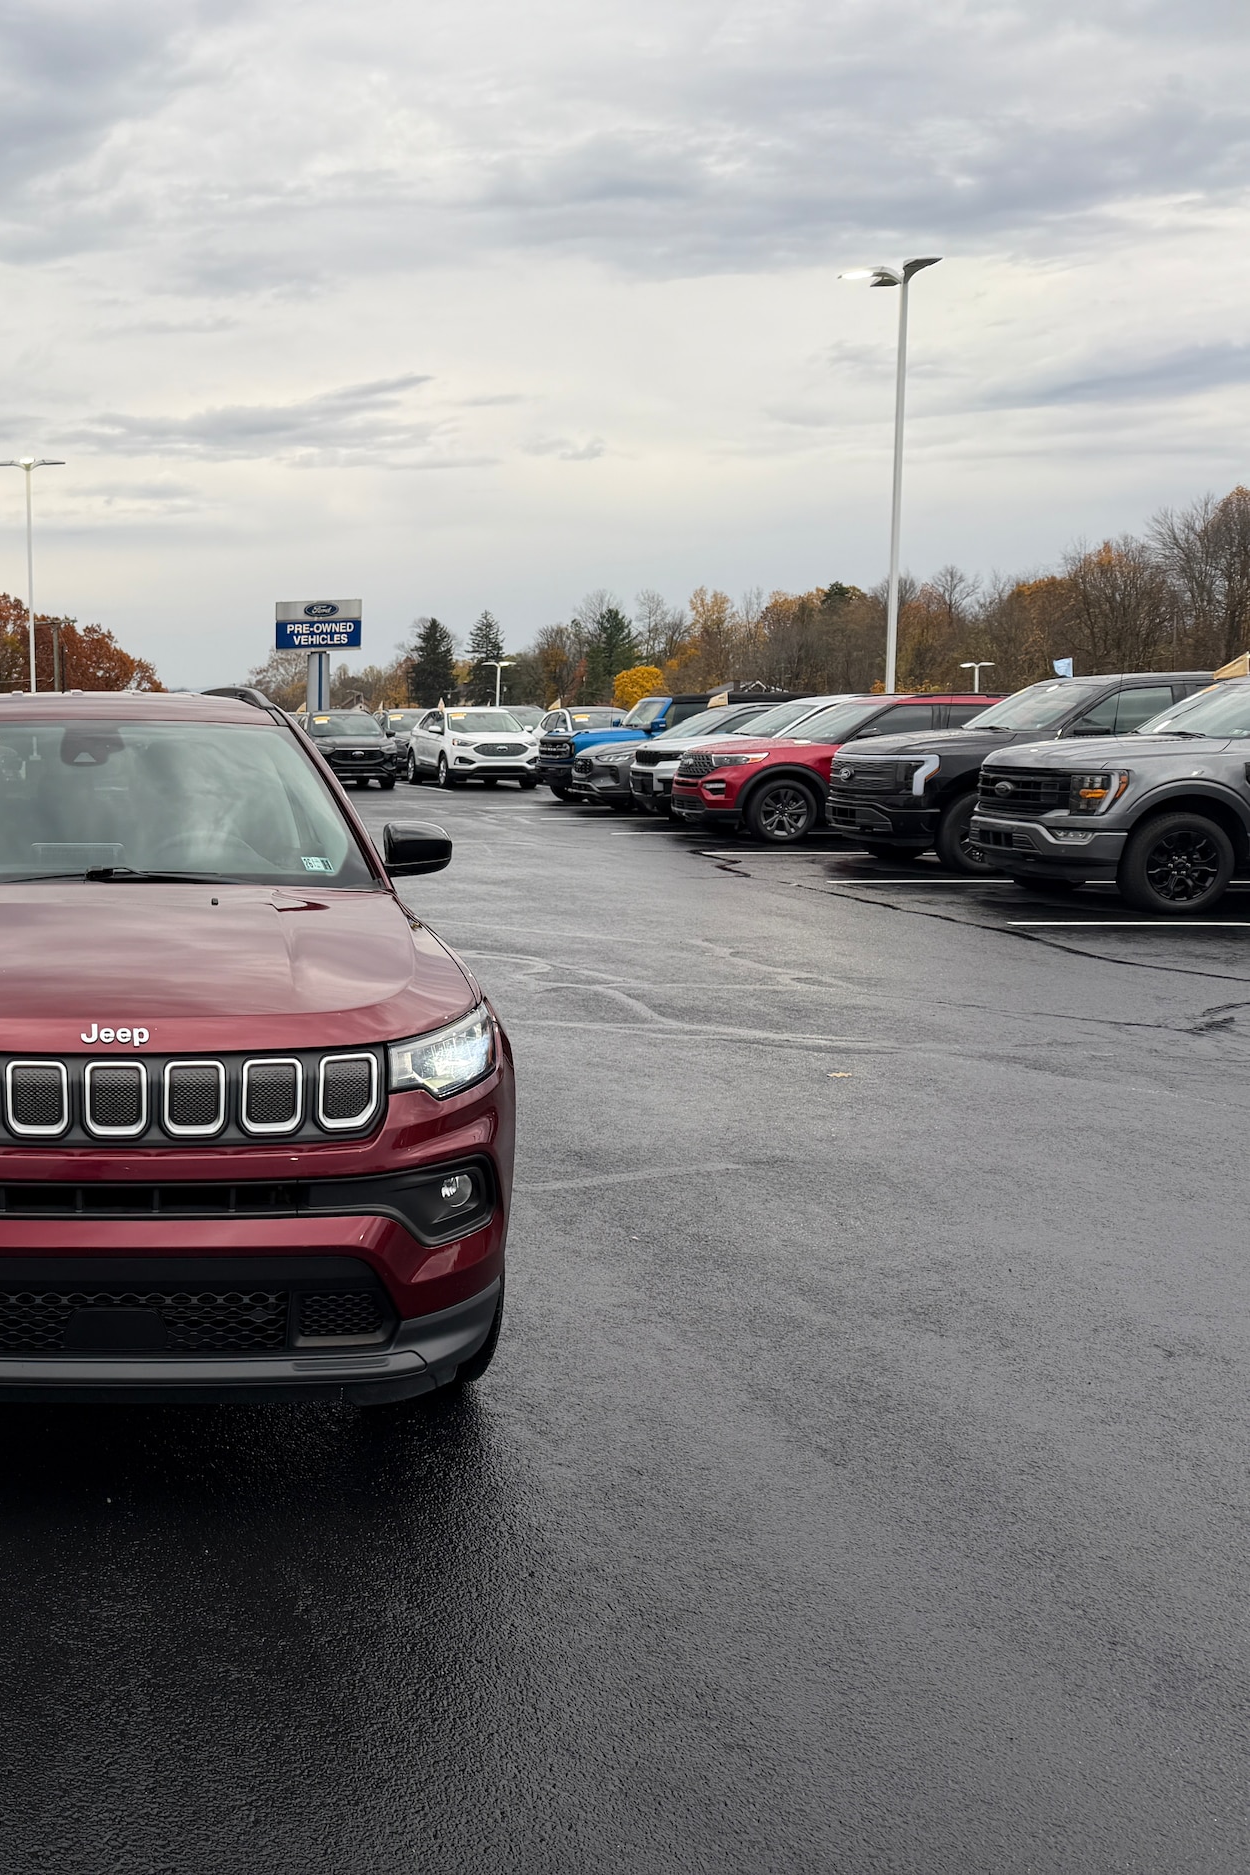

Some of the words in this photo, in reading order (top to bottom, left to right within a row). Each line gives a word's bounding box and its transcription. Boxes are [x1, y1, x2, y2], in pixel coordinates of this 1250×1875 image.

[311, 604, 332, 614] Ford
[286, 622, 354, 634] PRE-OWNED
[293, 633, 348, 645] VEHICLES
[80, 1023, 150, 1047] Jeep
